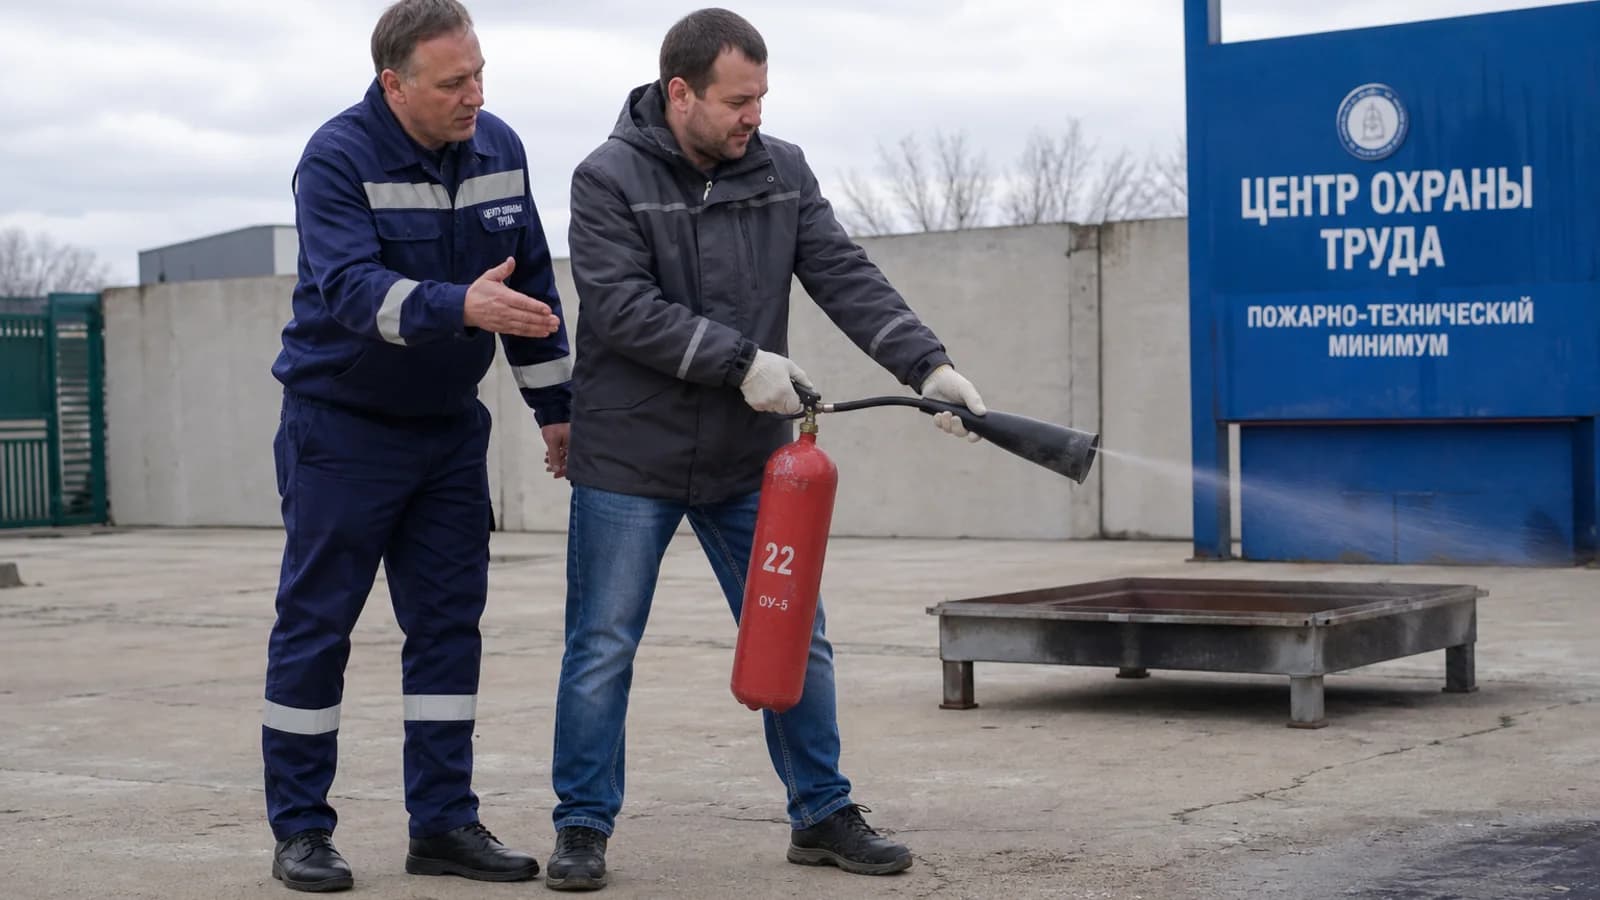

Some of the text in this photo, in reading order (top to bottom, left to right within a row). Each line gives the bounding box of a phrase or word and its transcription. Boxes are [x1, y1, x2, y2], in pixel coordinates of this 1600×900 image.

[1241, 165, 1533, 226] ЦЕНТР ОХРАНЫ
[1320, 225, 1445, 276] ТРУДА
[1247, 296, 1534, 327] ПОЖАРНО-ТЕХНИЧЕСКИЙ
[1328, 334, 1449, 357] МИНИМУМ
[762, 542, 795, 575] 22
[759, 595, 788, 611] ОУ-5
